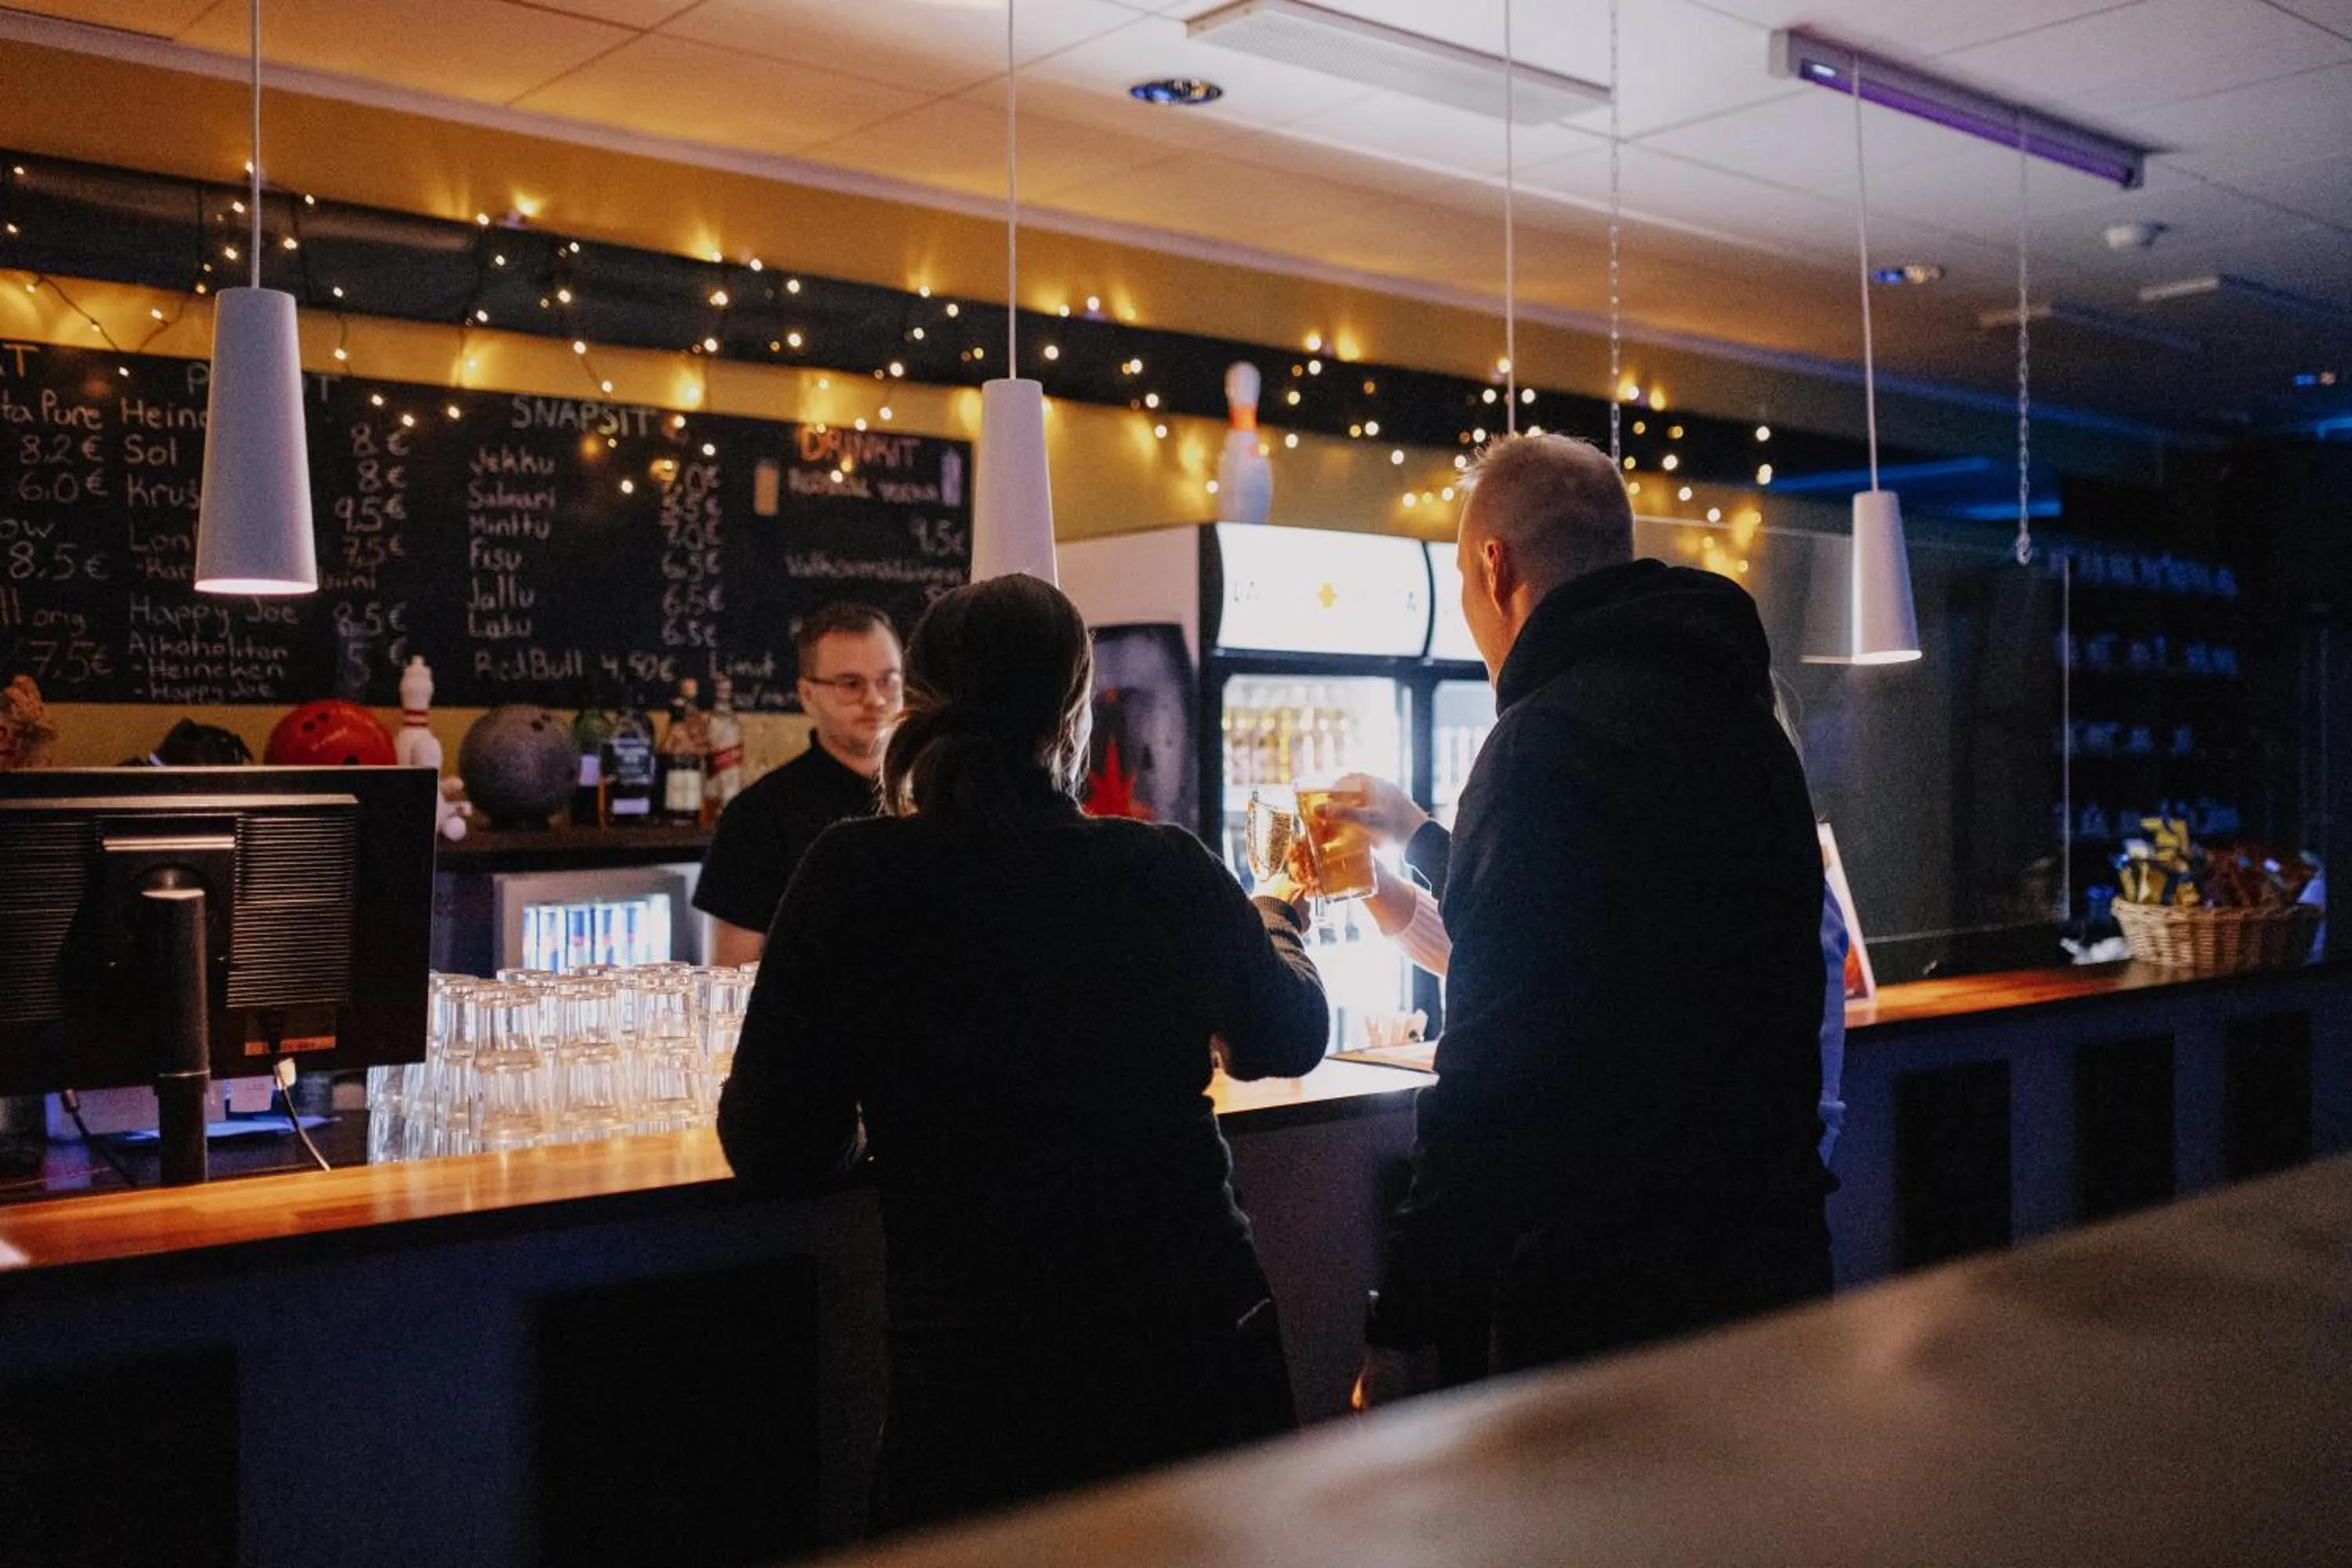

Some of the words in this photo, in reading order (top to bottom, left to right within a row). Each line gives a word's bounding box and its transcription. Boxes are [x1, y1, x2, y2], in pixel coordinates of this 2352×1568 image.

[511, 397, 657, 437] SNAPSIT
[123, 434, 179, 466] Sol
[467, 574, 535, 612] Jallu
[128, 593, 233, 639] Happy
[245, 594, 302, 625] Joe
